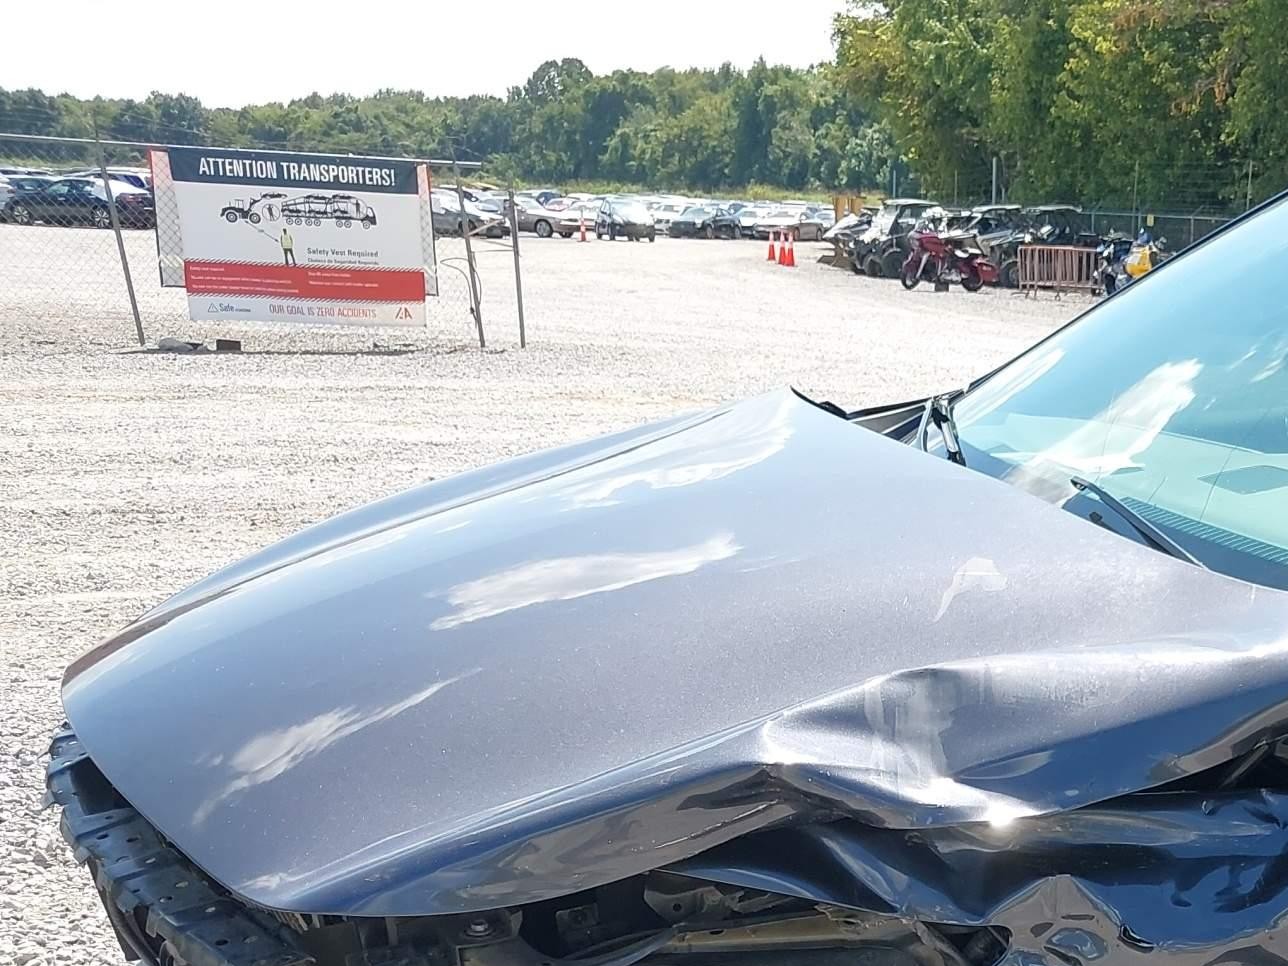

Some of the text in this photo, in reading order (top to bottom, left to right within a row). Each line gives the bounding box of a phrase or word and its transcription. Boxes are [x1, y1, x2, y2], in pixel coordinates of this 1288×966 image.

[199, 156, 396, 187] ATTENTION TRANSPORTERS!
[307, 247, 379, 258] Safety Vest Required
[219, 303, 235, 313] Safe
[269, 303, 377, 319] OUR GOAL IS ZERO ACCIDENTS
